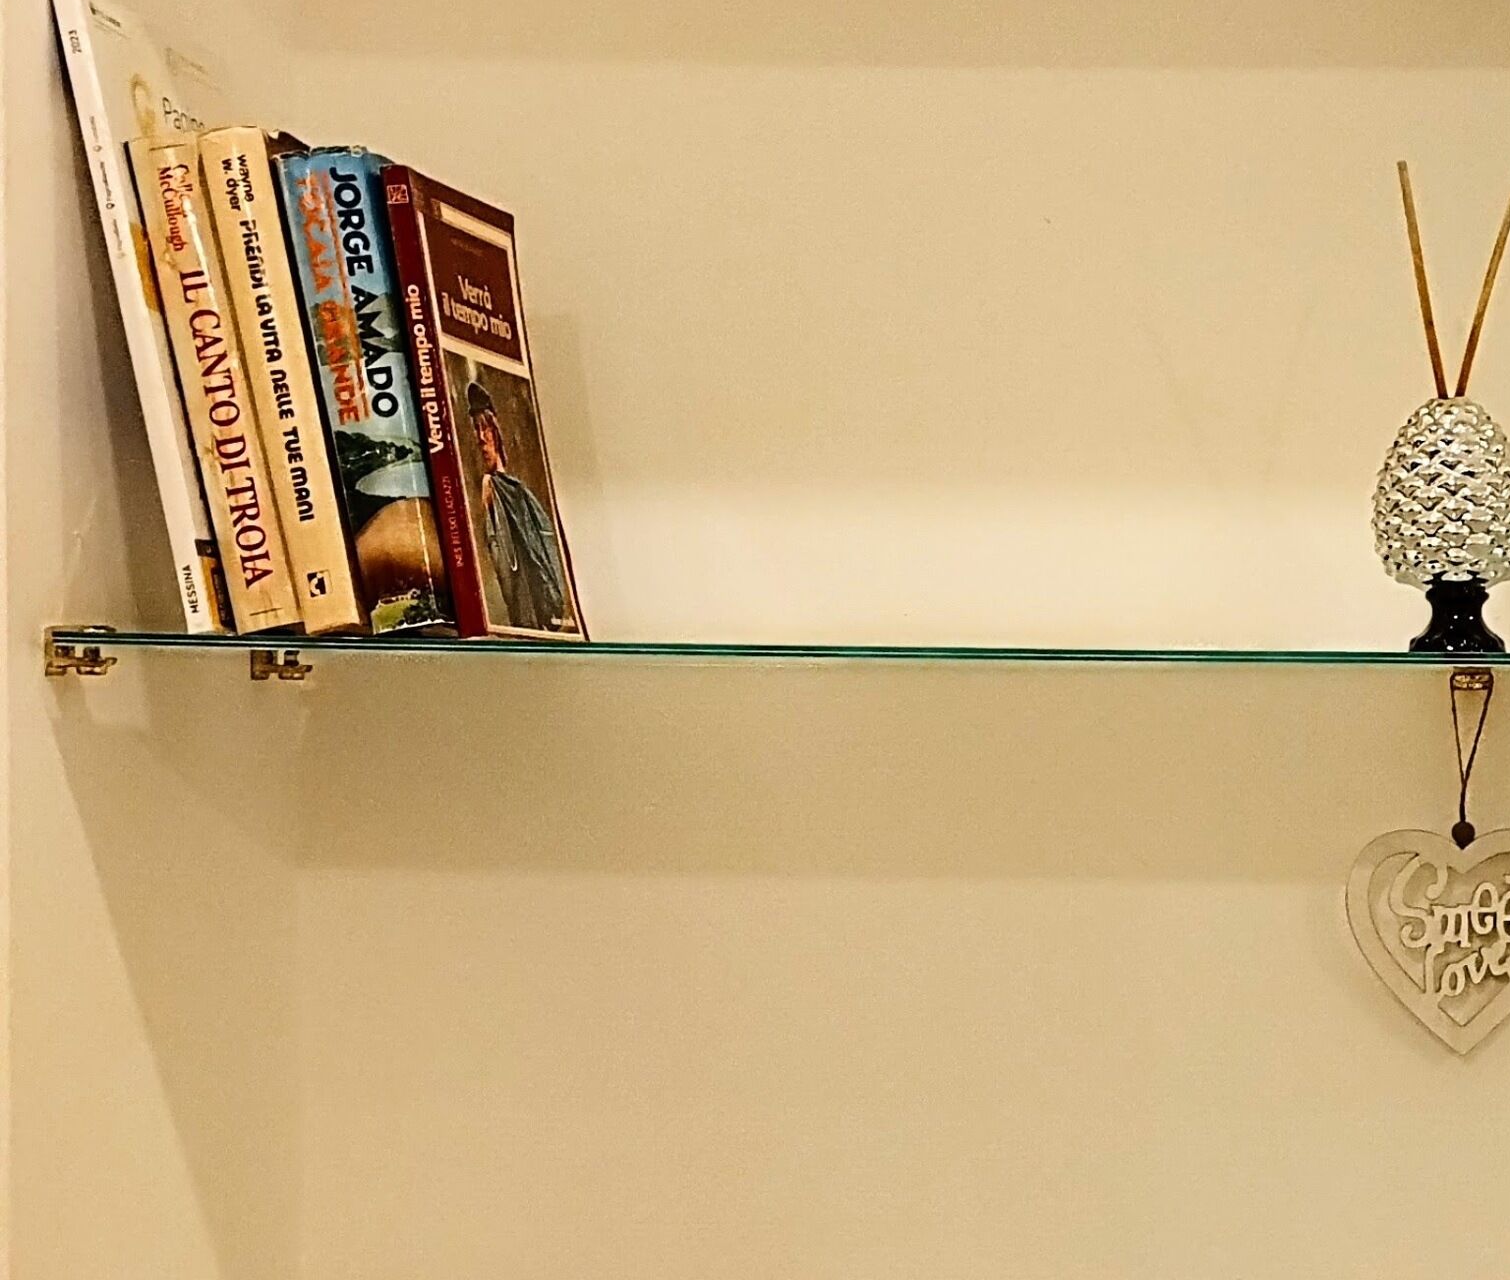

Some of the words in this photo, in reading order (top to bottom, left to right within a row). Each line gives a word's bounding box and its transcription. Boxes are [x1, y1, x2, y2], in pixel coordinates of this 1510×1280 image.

[158, 166, 189, 252] McCullough
[225, 178, 241, 212] dyer
[329, 166, 374, 277] JORGE
[179, 269, 209, 304] IL
[405, 283, 426, 320] mio
[457, 275, 492, 312] Verrà
[450, 298, 490, 335] tempo
[490, 314, 512, 341] mio
[188, 308, 241, 429] CANTO
[317, 299, 360, 426] GRANDE
[351, 285, 399, 419] AMADO
[411, 322, 434, 381] tempo
[420, 380, 438, 401] il
[215, 433, 252, 475] DI
[225, 476, 274, 589] TROIA
[180, 564, 200, 614] MESSINA
